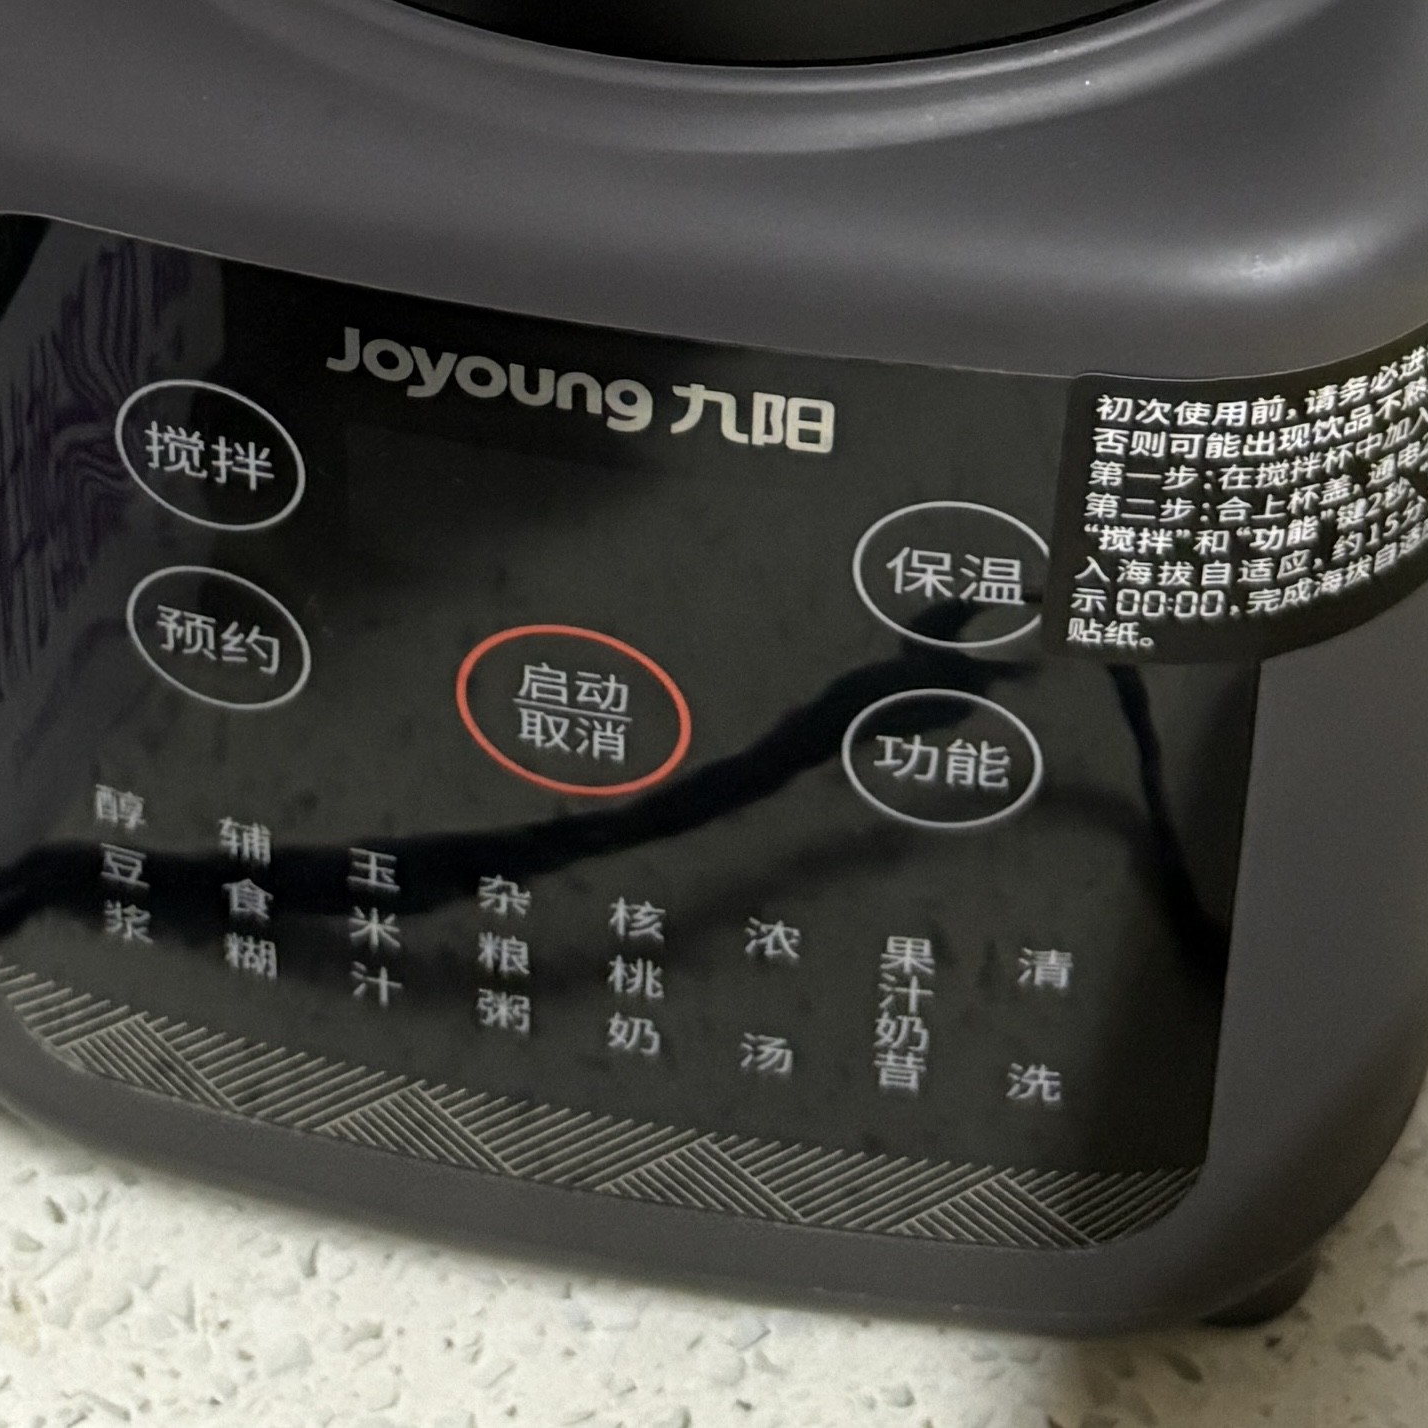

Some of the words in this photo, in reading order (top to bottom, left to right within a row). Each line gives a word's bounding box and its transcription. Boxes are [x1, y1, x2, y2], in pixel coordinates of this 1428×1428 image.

[143, 418, 276, 493] 搅拌
[326, 325, 654, 434] Joyoung
[670, 381, 837, 456] 九阳
[155, 603, 282, 677] 预约
[885, 545, 1026, 606] 保温
[1065, 616, 1155, 649] 贴纸。
[515, 660, 630, 716] 启动
[516, 709, 628, 764] 取消
[873, 734, 1011, 789] 功能
[94, 784, 154, 944] 醇豆浆
[219, 816, 278, 979] 辅食糊
[347, 847, 404, 1007] 玉米汁
[477, 874, 532, 1036] 杂粮粥
[607, 896, 667, 1056] 核桃奶
[739, 916, 802, 1075] 浓汤
[873, 935, 936, 1094] 果汁奶昔
[1005, 946, 1073, 1104] 清洗
